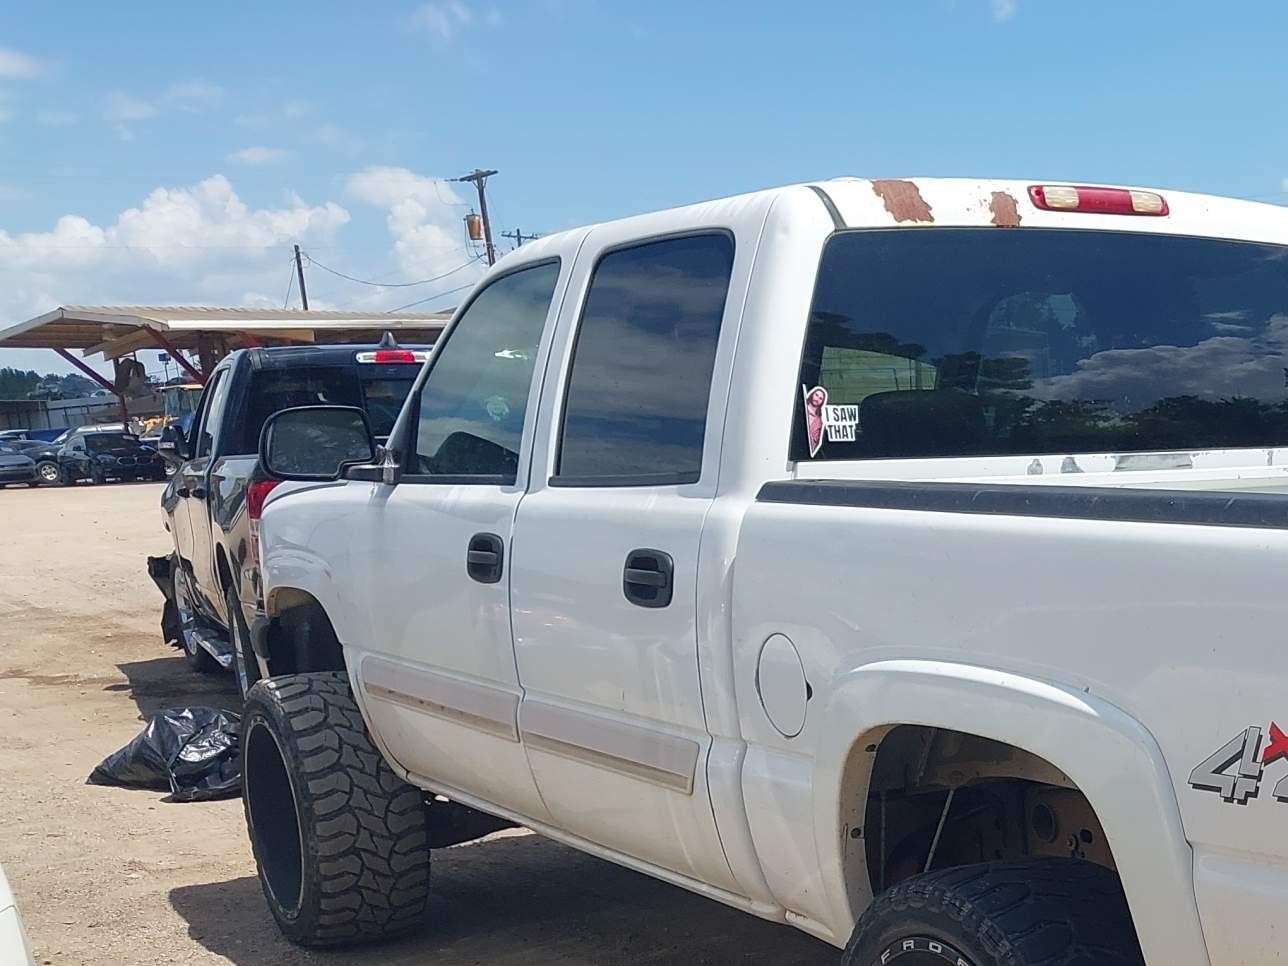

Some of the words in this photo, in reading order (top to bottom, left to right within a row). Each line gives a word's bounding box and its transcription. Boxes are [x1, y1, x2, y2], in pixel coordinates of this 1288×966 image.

[824, 406, 830, 423] I
[832, 406, 857, 423] SAW
[827, 424, 854, 440] THAT
